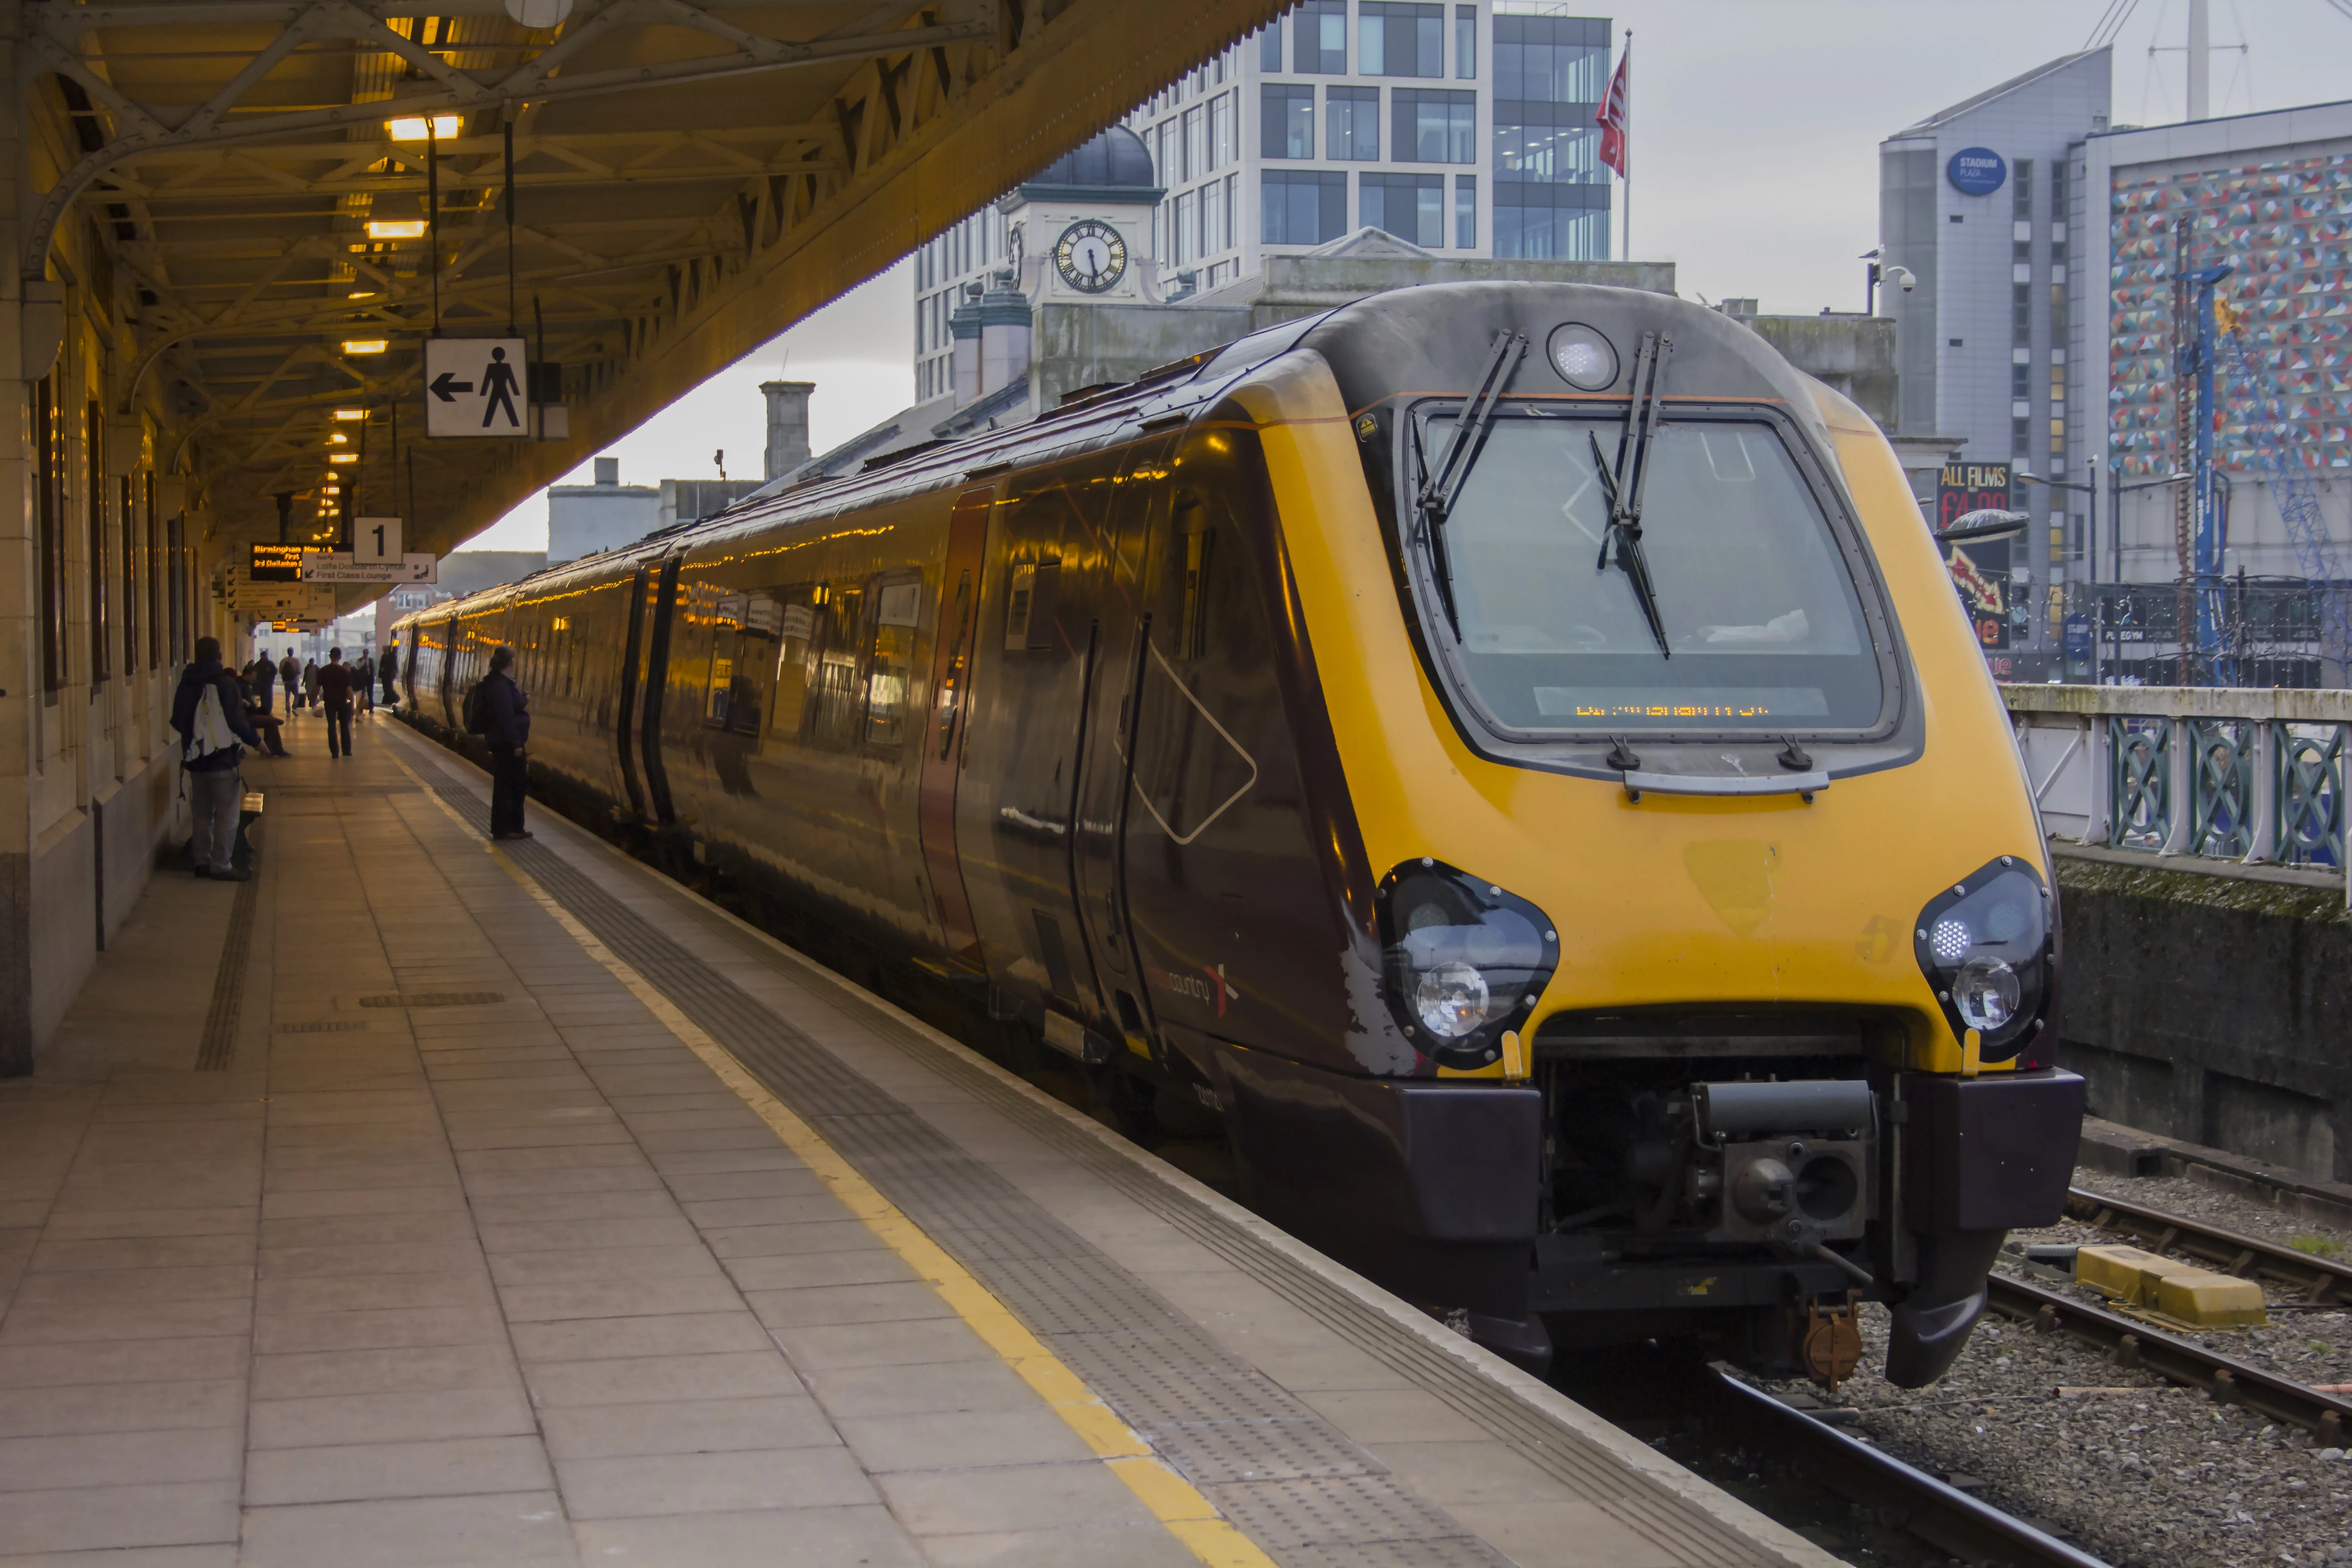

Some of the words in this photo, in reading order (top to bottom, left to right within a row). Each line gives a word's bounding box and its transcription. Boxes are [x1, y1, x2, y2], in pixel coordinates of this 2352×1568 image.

[1960, 157, 1997, 168] STADIUM
[1960, 168, 1981, 177] PLAZA
[1940, 466, 1965, 486] ALL
[1968, 466, 2006, 487] FILMS
[372, 524, 384, 556] 1
[2106, 631, 2143, 640] PUEGYM
[1988, 657, 2012, 675] ue
